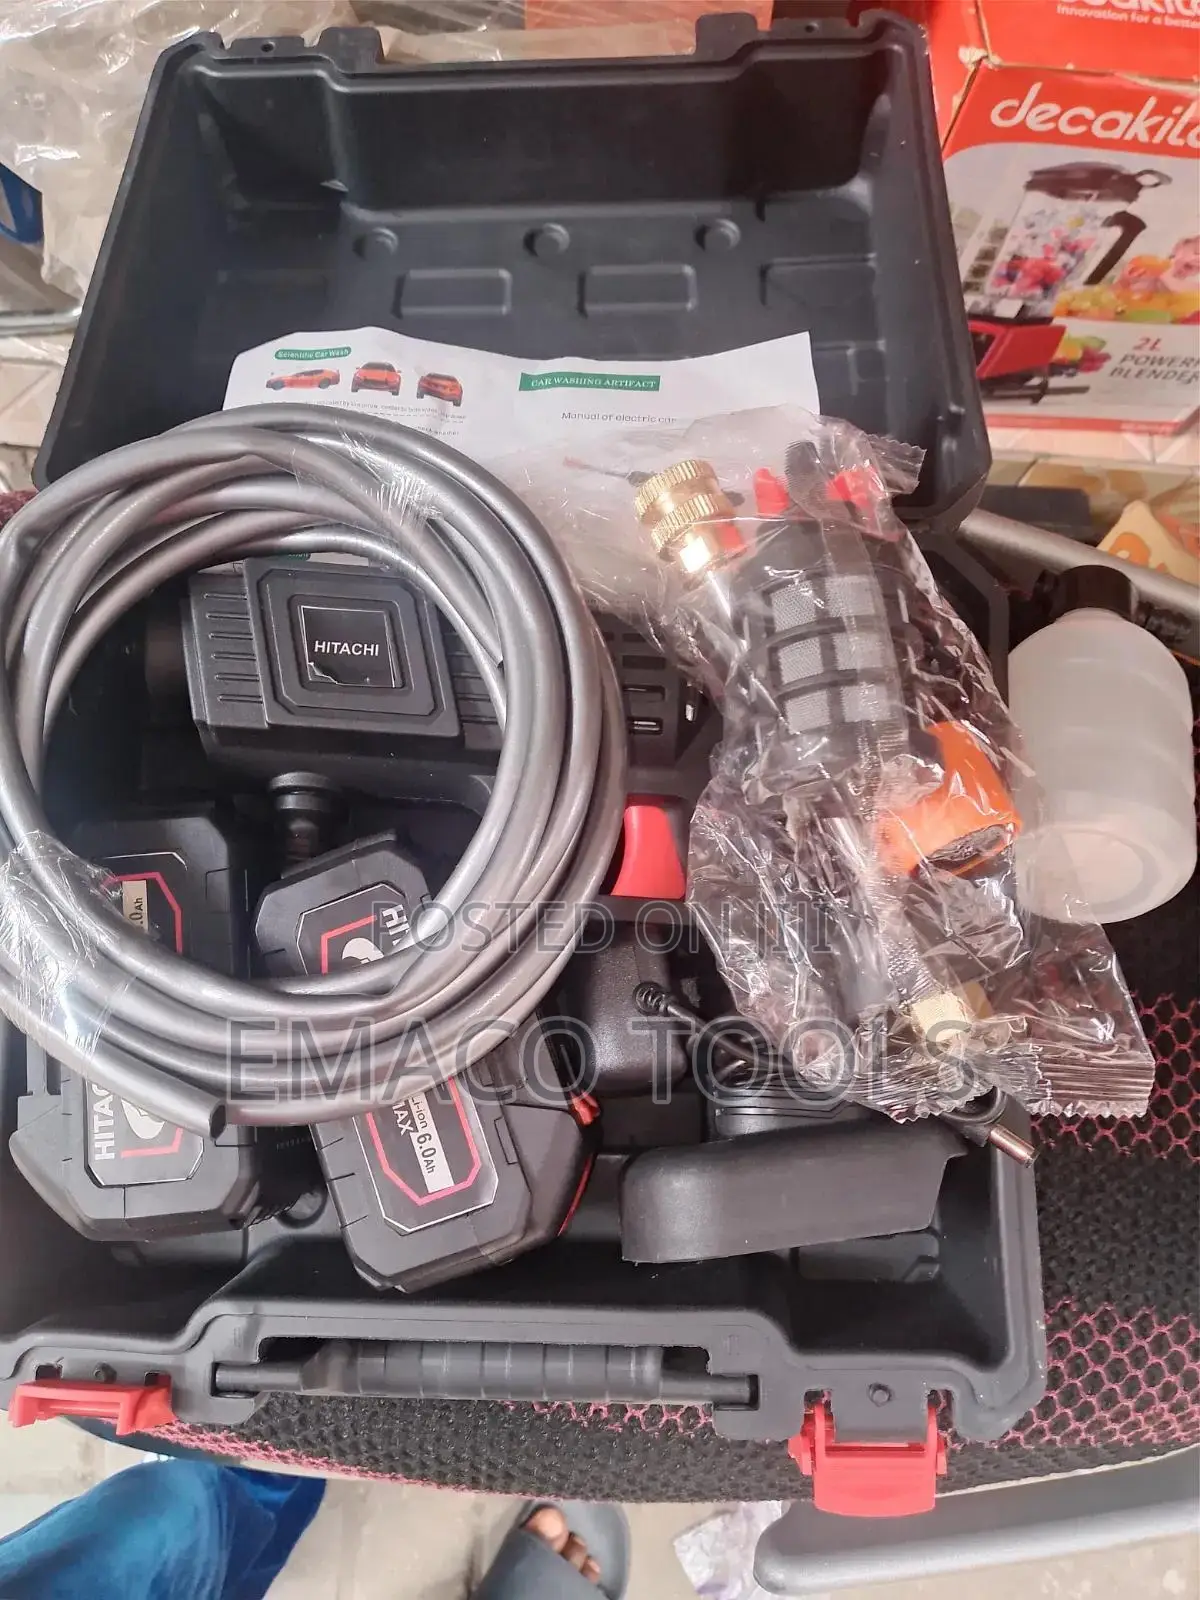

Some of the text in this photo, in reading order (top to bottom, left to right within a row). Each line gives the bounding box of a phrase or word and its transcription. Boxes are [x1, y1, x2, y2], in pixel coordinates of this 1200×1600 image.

[1130, 11, 1150, 24] for
[531, 376, 656, 388] CAR WASHING ARTIFACT
[561, 411, 600, 421] Manual
[602, 413, 614, 421] of
[615, 414, 656, 423] electric
[314, 640, 379, 656] HITACHI
[416, 1132, 437, 1174] 6.0Ah
